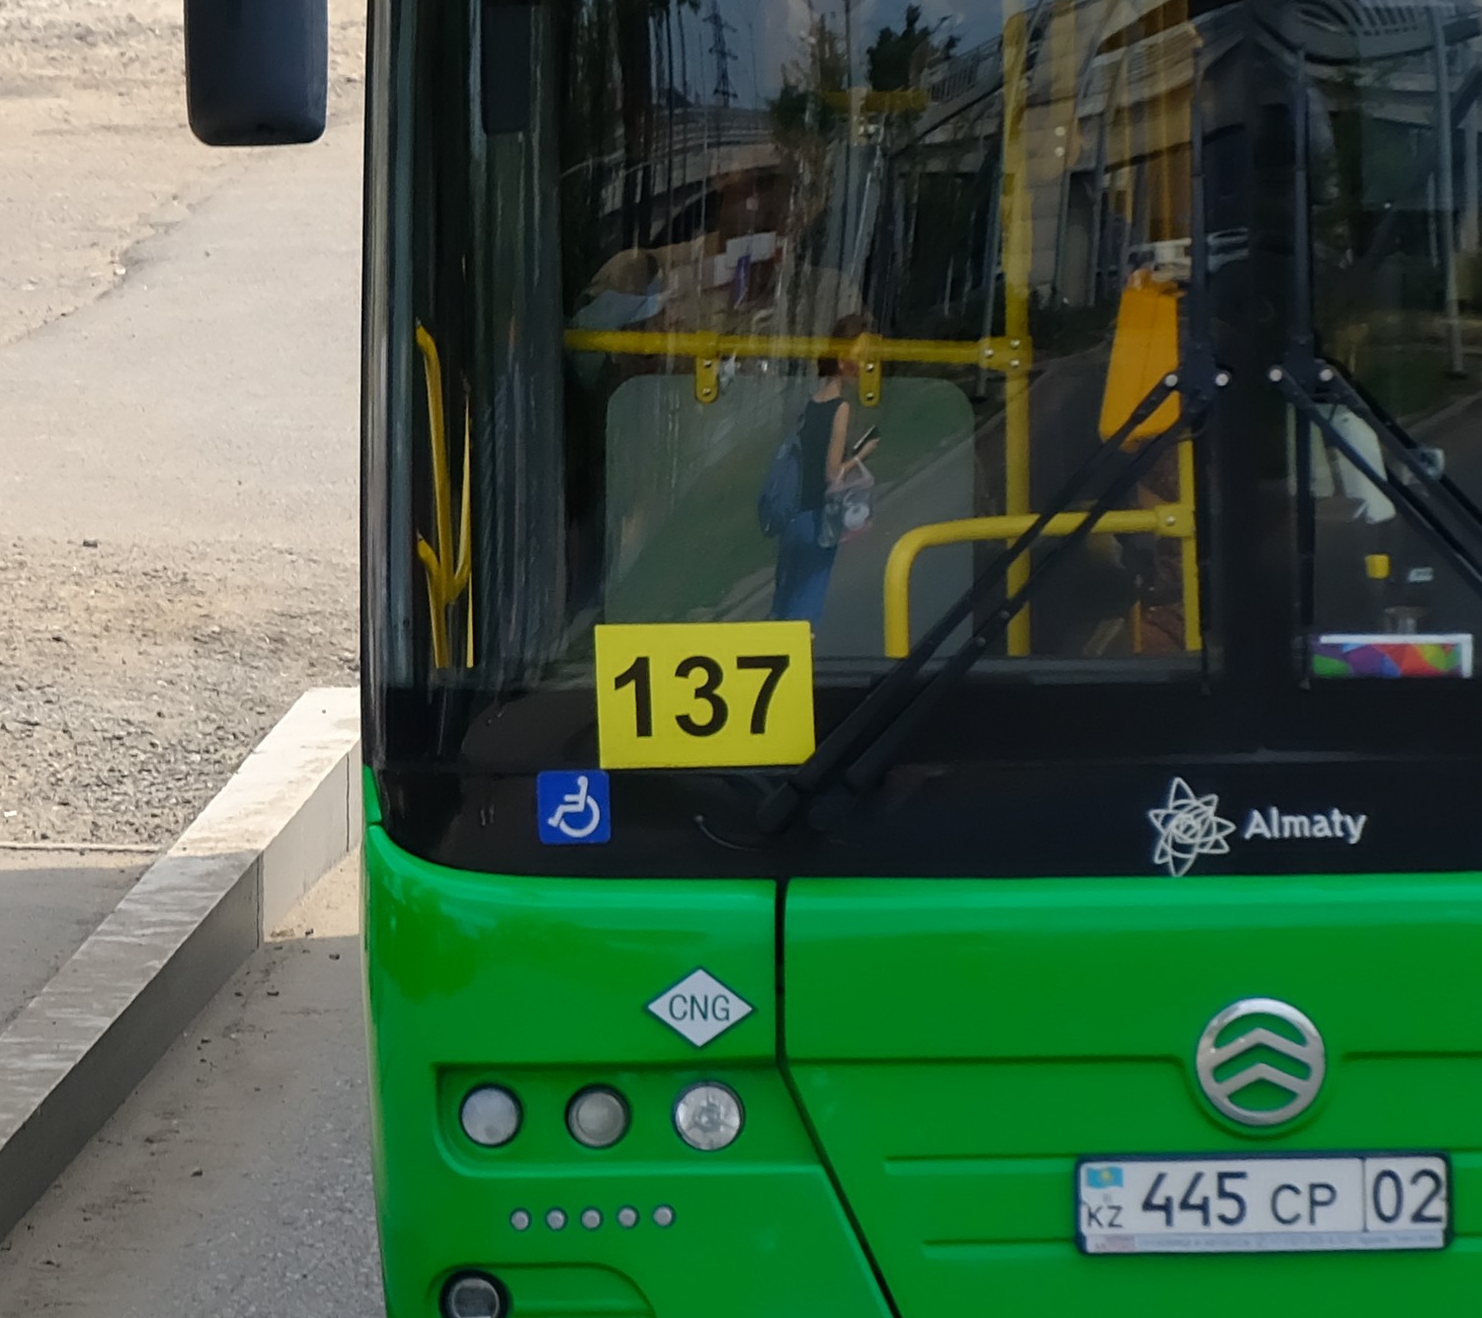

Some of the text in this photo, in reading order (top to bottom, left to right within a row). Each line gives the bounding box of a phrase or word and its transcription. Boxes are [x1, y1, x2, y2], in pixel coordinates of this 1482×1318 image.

[614, 654, 791, 737] 137
[1243, 805, 1369, 845] Almaty
[668, 993, 731, 1021] CNG
[1087, 1168, 1444, 1228] KZ 445 CP 02
